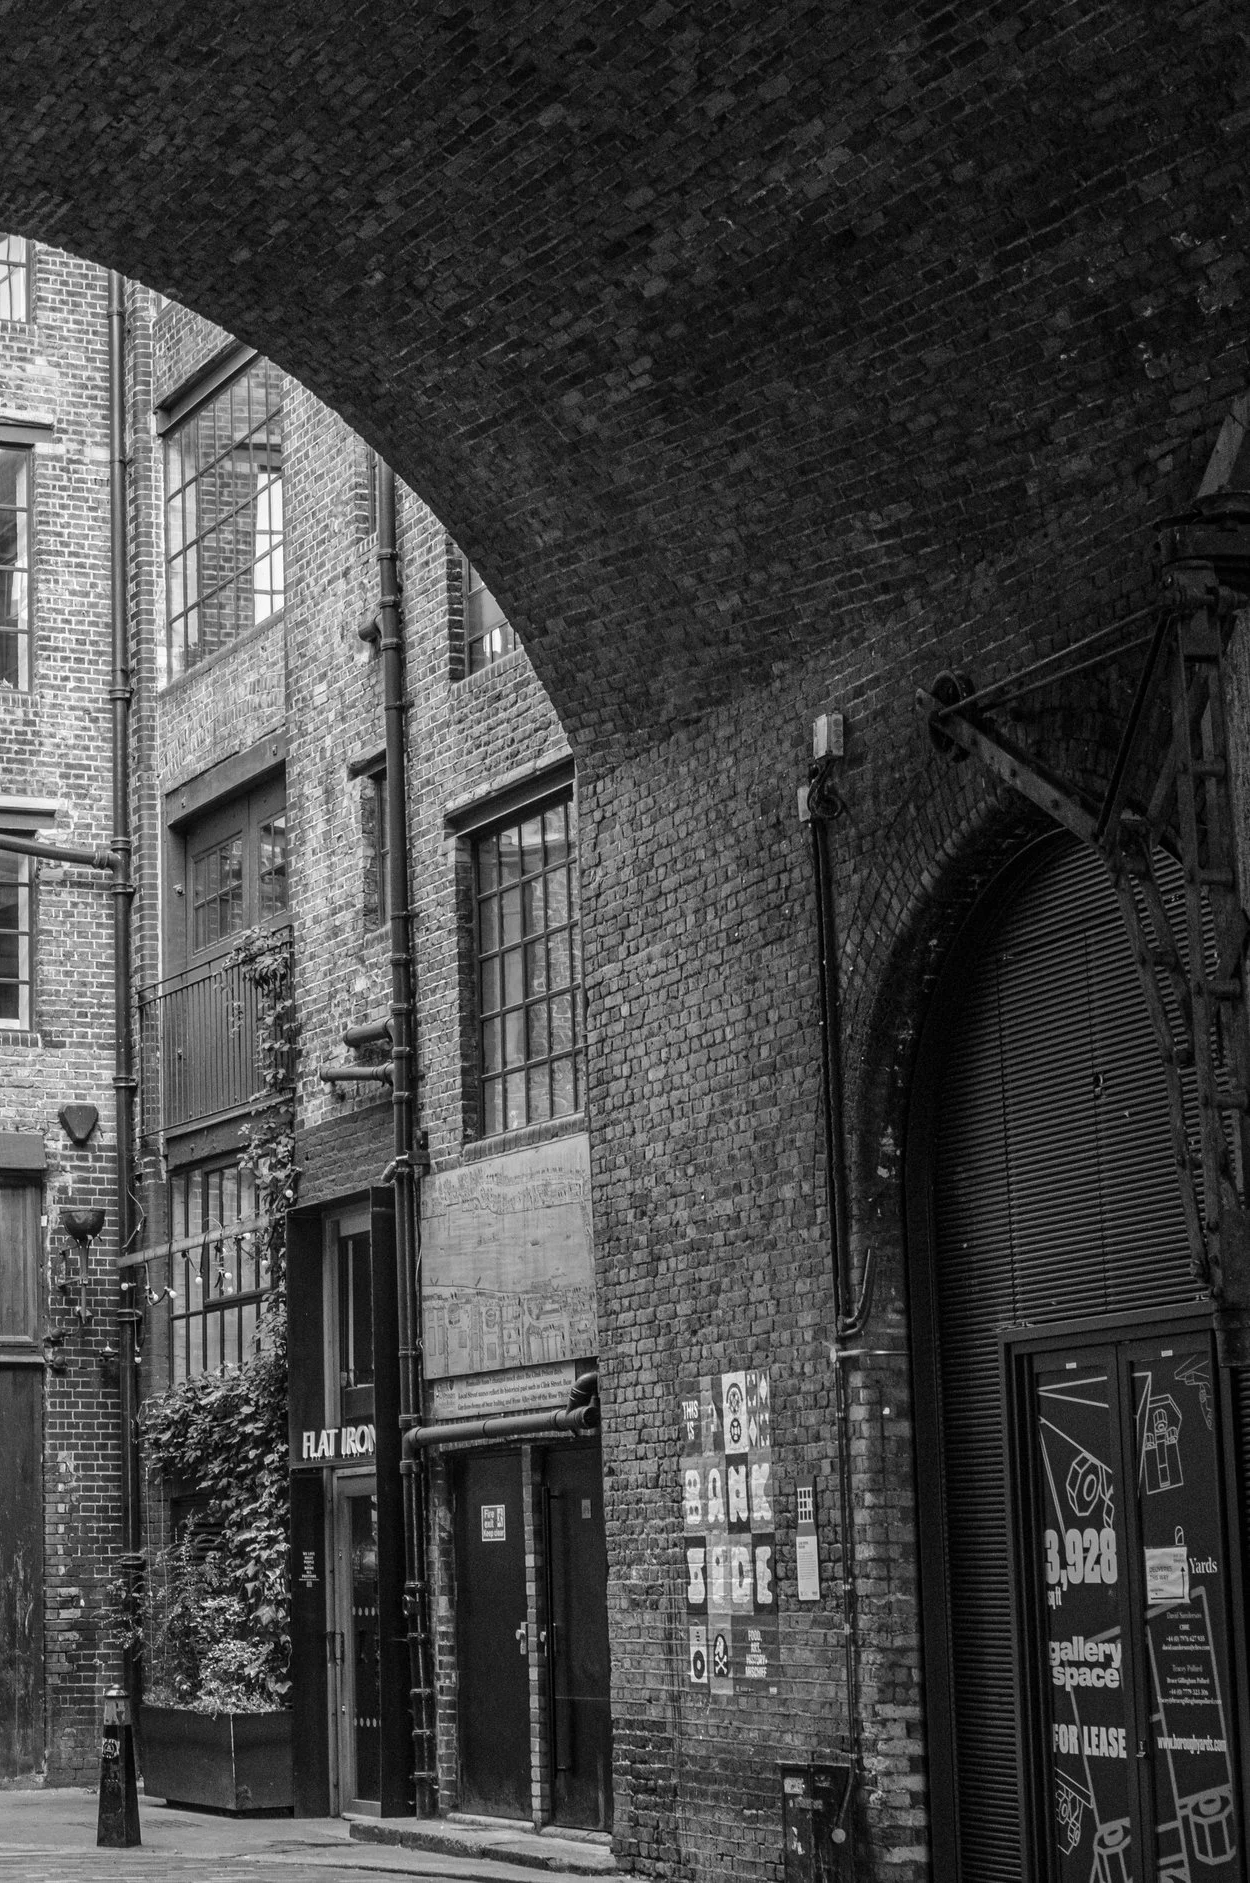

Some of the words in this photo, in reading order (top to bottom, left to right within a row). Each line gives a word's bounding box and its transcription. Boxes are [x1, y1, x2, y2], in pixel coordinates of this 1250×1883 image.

[682, 1400, 698, 1419] THIS
[303, 1429, 338, 1458] FLAT
[341, 1424, 376, 1455] IRON
[687, 1421, 694, 1440] IS
[685, 1463, 771, 1524] BANK
[484, 1509, 494, 1519] Fire
[1044, 1528, 1118, 1591] 3,928
[1189, 1557, 1218, 1574] Yards
[687, 1546, 772, 1604] SIDE
[748, 1630, 762, 1642] FOOD,
[1049, 1635, 1122, 1668] gallery
[1052, 1666, 1120, 1691] space
[1053, 1723, 1079, 1754] FOR
[1083, 1725, 1127, 1758] LEASE
[1157, 1733, 1227, 1754] www.boroughyards.com
